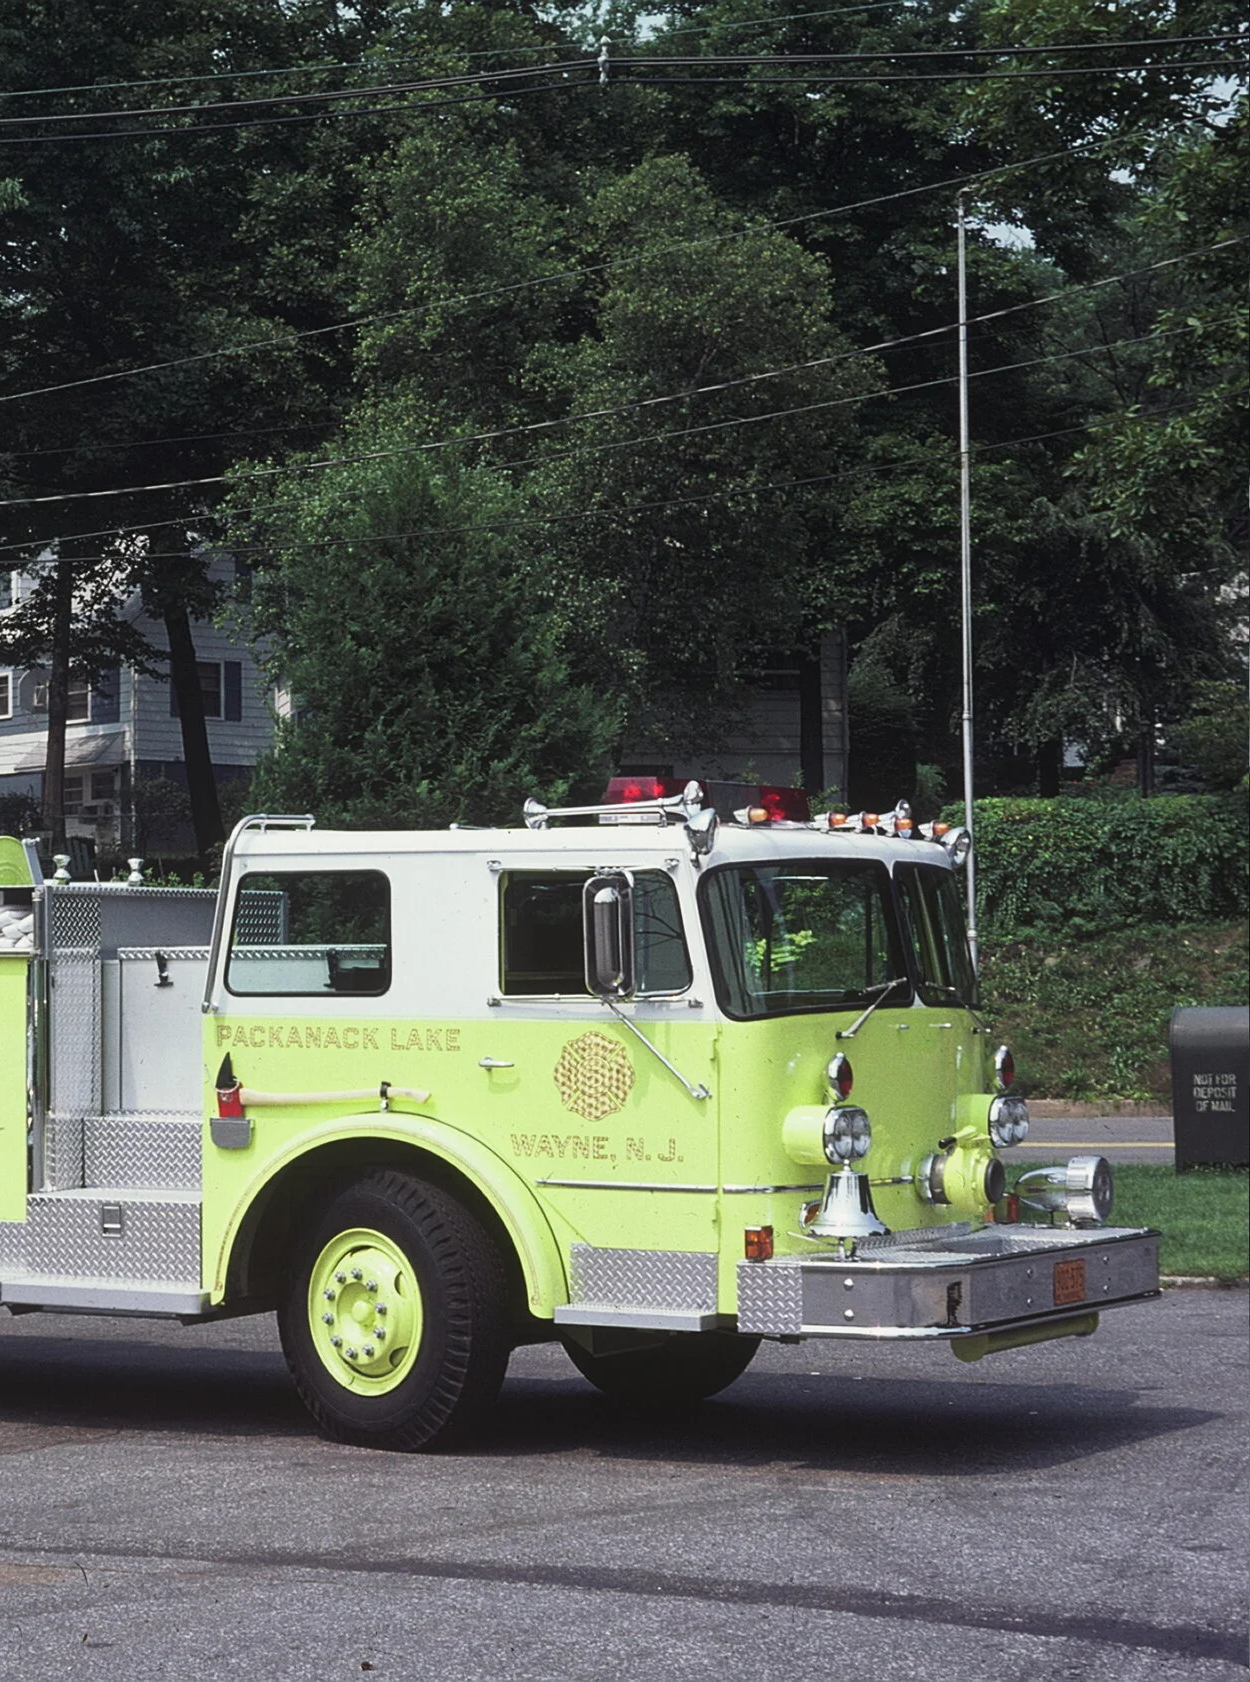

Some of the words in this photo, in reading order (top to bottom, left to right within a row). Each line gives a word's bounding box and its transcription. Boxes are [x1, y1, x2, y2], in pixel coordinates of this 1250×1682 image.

[214, 1024, 379, 1049] PACKANACK
[390, 1028, 461, 1051] LAKE
[1193, 1074, 1213, 1085] NOT
[1215, 1074, 1237, 1085] FOR
[1193, 1086, 1237, 1099] DEPOSIT
[1196, 1101, 1209, 1112] OF
[1211, 1100, 1236, 1112] MAIL
[510, 1133, 617, 1161] WAYNE,
